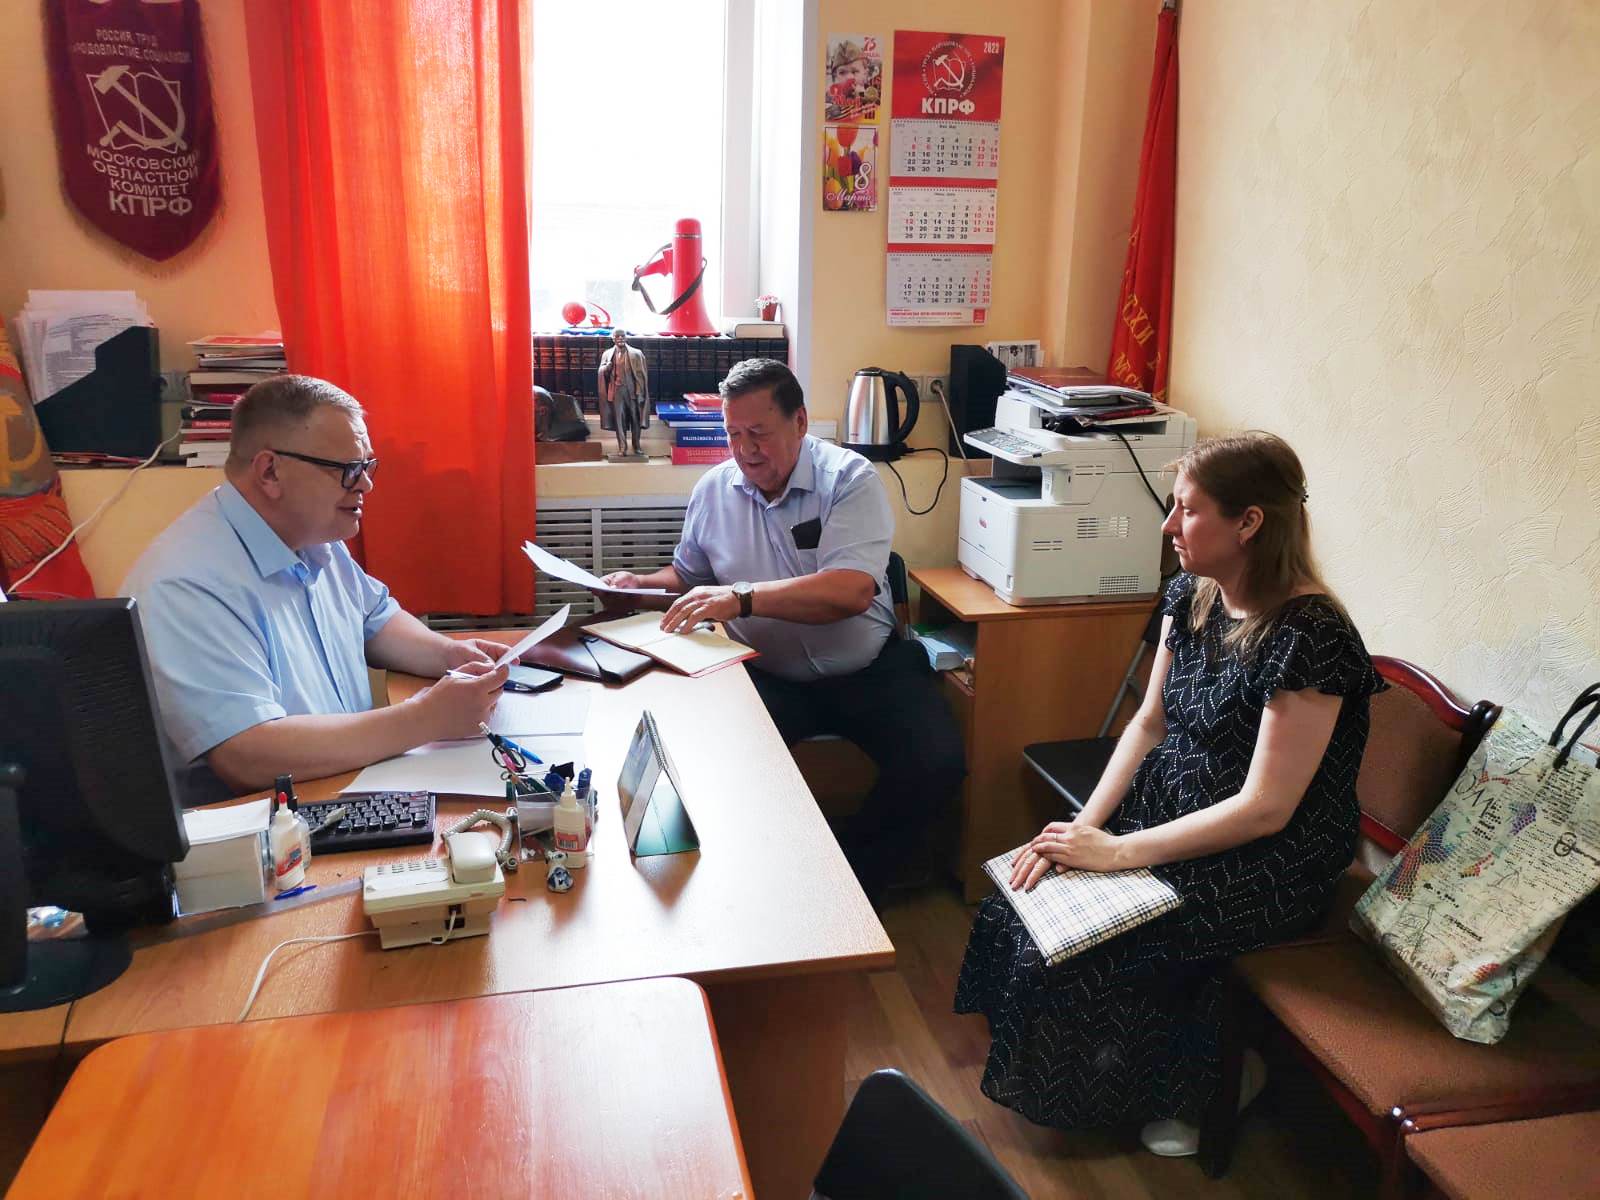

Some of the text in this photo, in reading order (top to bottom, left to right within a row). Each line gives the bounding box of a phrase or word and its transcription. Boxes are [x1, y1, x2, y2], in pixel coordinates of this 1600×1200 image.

[921, 97, 975, 115] КПРФ
[110, 178, 189, 196] КОМИТЕТ
[855, 162, 872, 190] 8
[109, 190, 193, 216] КПРФ
